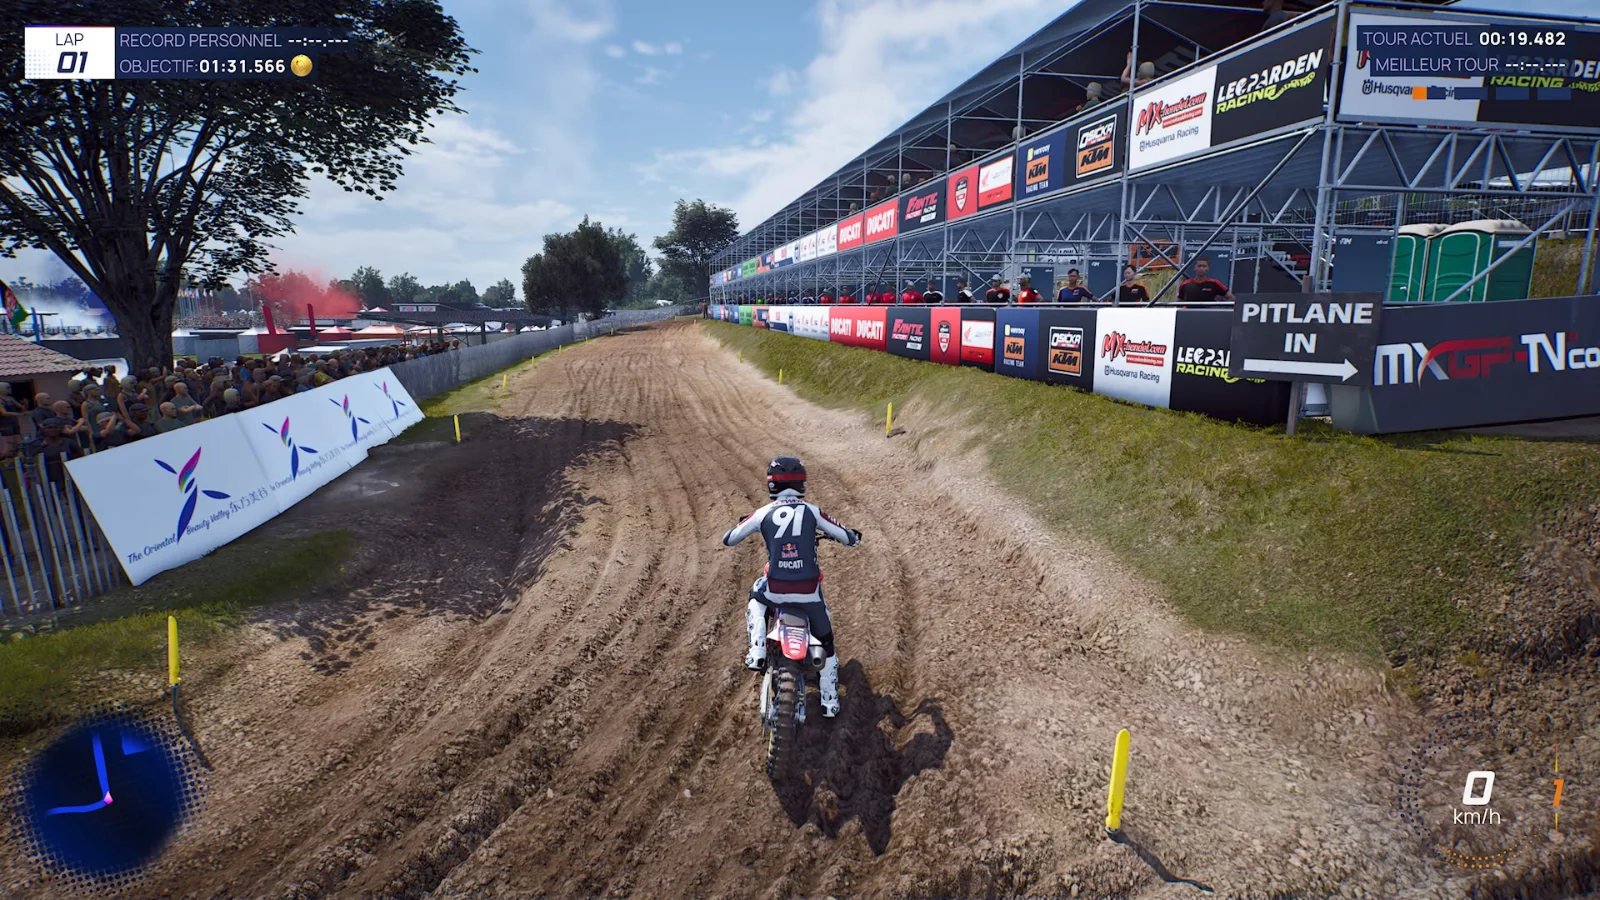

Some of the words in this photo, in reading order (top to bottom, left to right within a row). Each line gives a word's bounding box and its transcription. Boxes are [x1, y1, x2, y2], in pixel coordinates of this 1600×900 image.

[1217, 48, 1324, 103] LEOPARDEN
[1489, 76, 1565, 88] RACING
[1216, 84, 1277, 115] RACING
[1145, 133, 1175, 149] Husqvarna
[1176, 126, 1199, 139] Racing
[1080, 146, 1110, 167] KTM
[1028, 162, 1047, 180] KTM
[906, 192, 938, 213] FANTIC
[866, 208, 895, 236] DUCATI
[839, 222, 862, 244] DUCATI
[1242, 303, 1374, 324] PITLANE
[831, 317, 852, 336] DUCATI
[856, 319, 884, 341] DUCATI
[892, 318, 924, 336] FANTIC
[1006, 341, 1023, 354] KTM
[1284, 332, 1317, 354] IN
[1052, 352, 1078, 366] KTM
[1109, 366, 1138, 379] Husqvarna
[1139, 370, 1160, 384] Racing
[772, 505, 806, 539] 91
[127, 552, 143, 565] The
[143, 533, 177, 557] Oriental
[186, 519, 210, 535] Beauty
[210, 509, 230, 524] Valley
[778, 560, 804, 569] DUCATI
